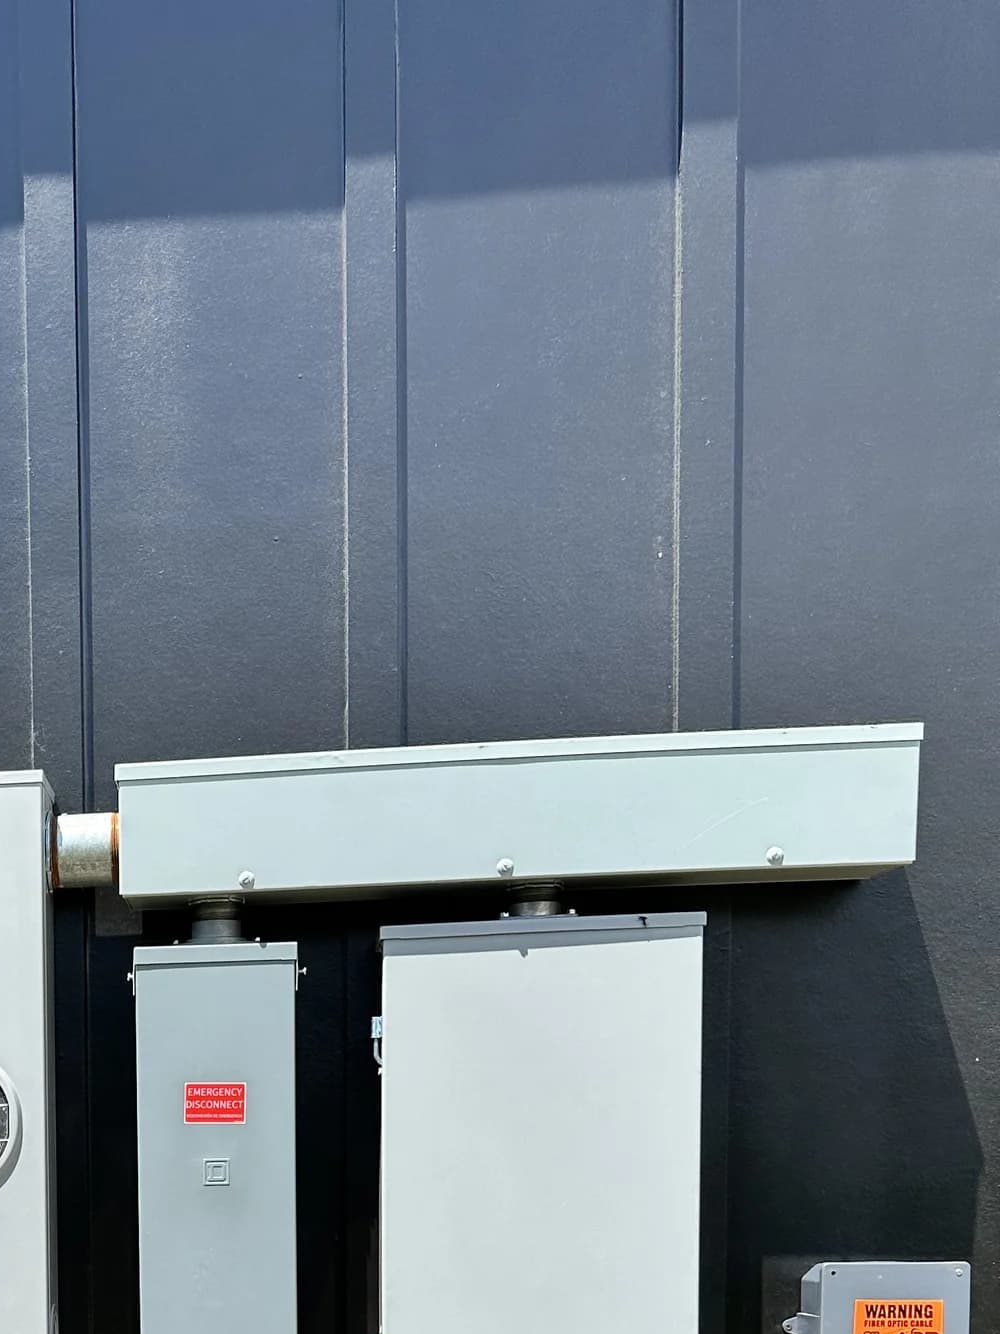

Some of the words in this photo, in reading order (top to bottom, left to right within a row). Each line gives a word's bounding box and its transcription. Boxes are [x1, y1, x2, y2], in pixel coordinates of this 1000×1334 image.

[187, 1087, 243, 1097] EMERGENCY
[186, 1100, 243, 1109] DISCONNECT
[865, 1304, 933, 1319] WARNING
[864, 1320, 885, 1328] FIBER
[887, 1320, 908, 1328] OPTIC
[910, 1320, 933, 1328] CABLE
